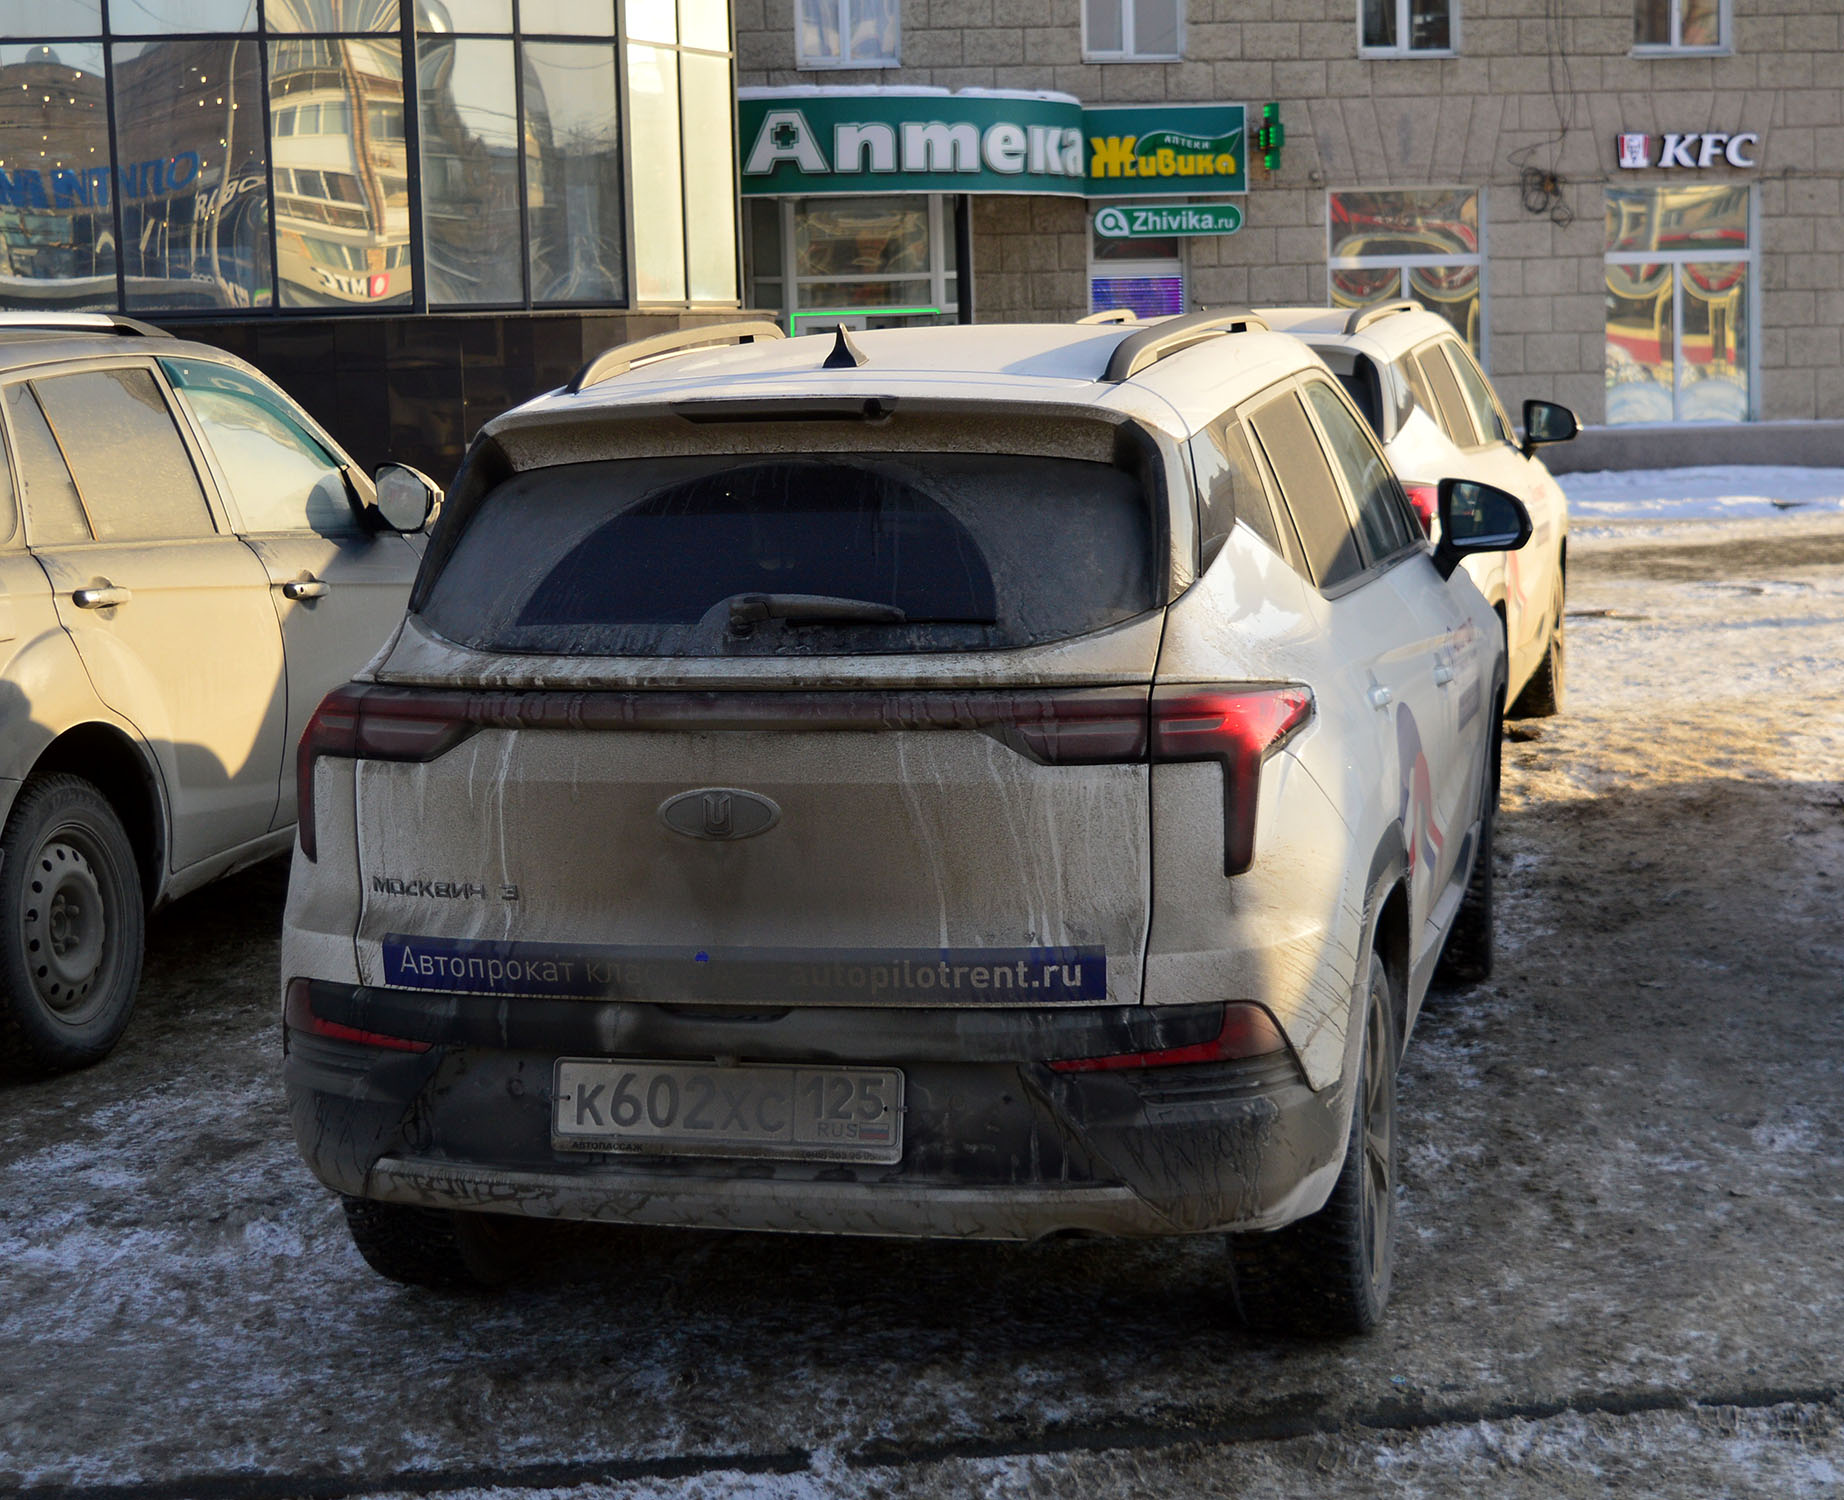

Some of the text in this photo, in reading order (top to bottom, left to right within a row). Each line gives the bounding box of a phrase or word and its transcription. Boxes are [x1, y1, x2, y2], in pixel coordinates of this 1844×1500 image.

[743, 109, 1084, 176] Аптека
[1090, 136, 1236, 177] Живика
[1657, 133, 1759, 167] KFC
[1132, 211, 1235, 231] Zhivika.ru
[501, 884, 519, 901] 3
[400, 946, 574, 987] Автопрокат
[789, 960, 1082, 995] autopilotrent.ru
[576, 1073, 786, 1132] К602ХС
[802, 1076, 885, 1120] 125
[816, 1122, 858, 1138] RUS
